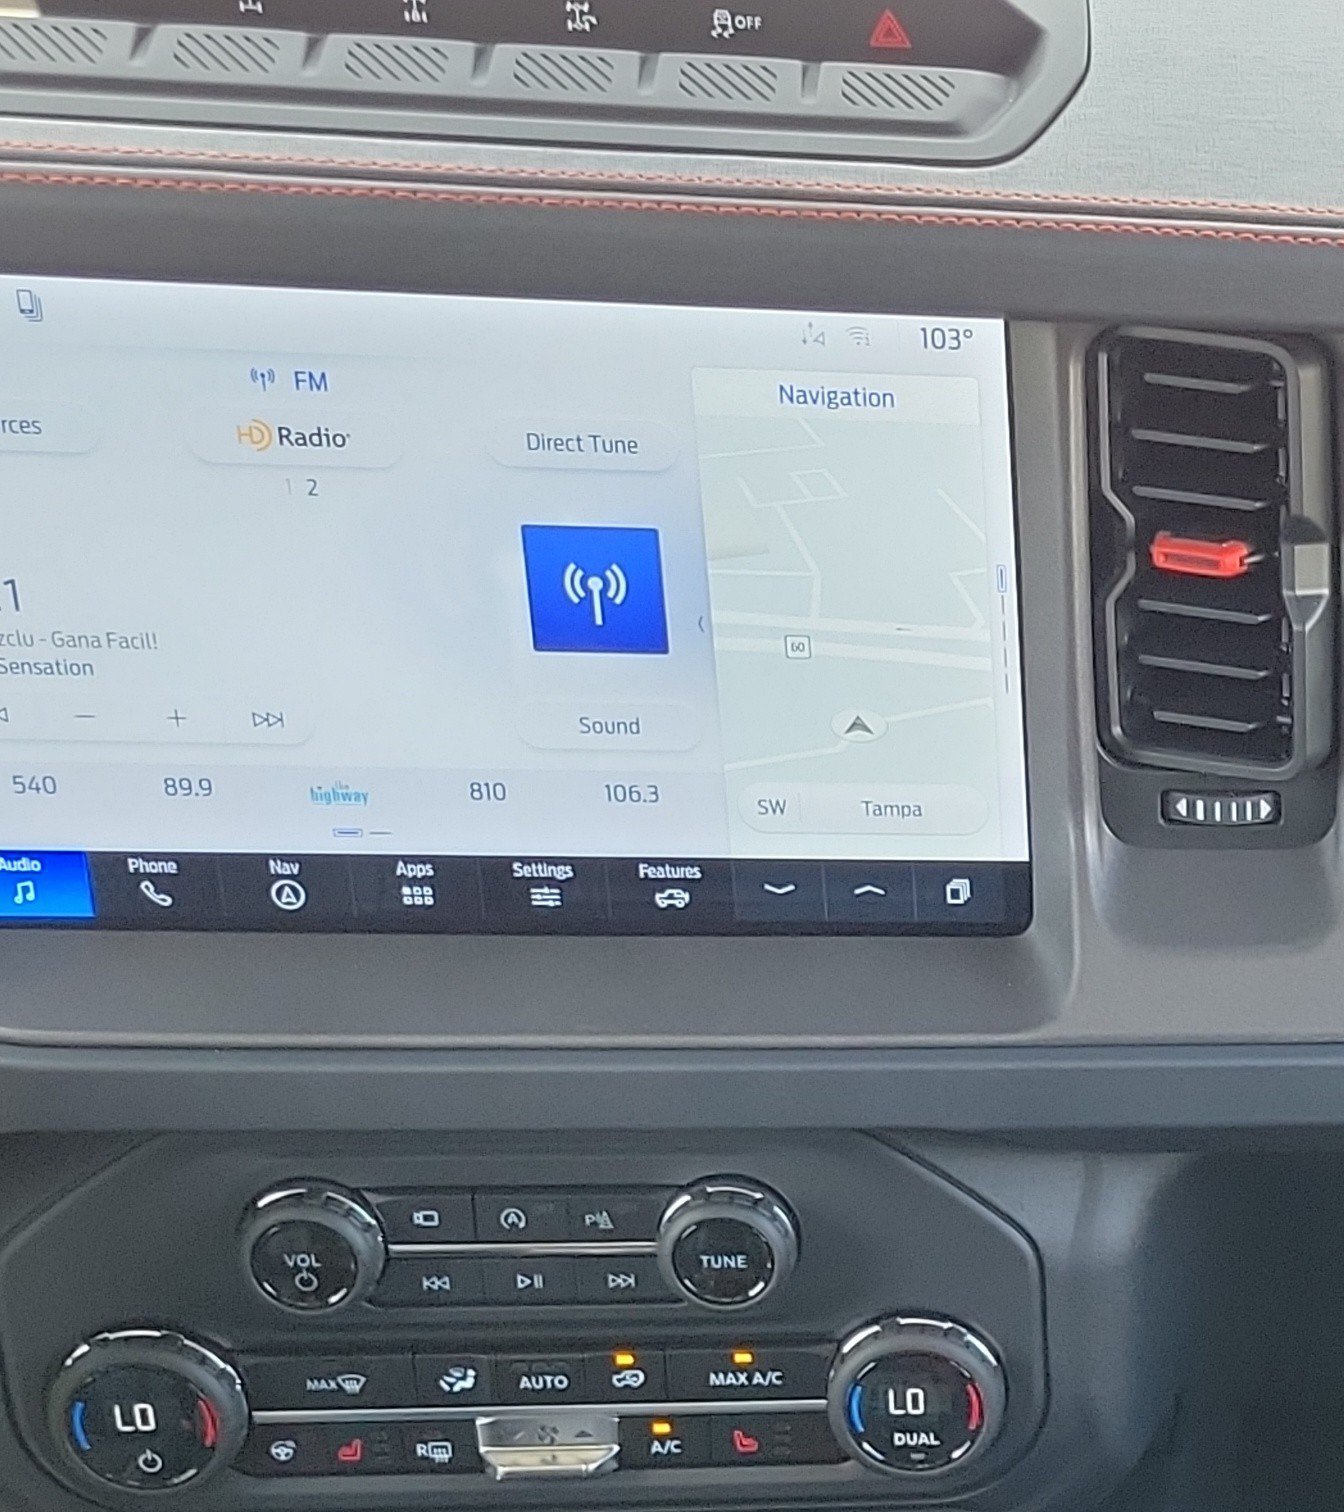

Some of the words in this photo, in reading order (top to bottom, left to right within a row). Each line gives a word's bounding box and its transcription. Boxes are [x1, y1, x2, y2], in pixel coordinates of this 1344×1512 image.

[734, 15, 763, 31] OFF
[919, 326, 974, 351] 103°
[294, 370, 328, 391] FM
[778, 384, 896, 409] Navigation
[277, 426, 346, 448] Radio
[526, 432, 585, 453] Direct
[588, 433, 638, 455] Tune
[306, 478, 319, 497] 2
[51, 630, 102, 649] Gana
[106, 631, 159, 650] Facil!
[0, 657, 94, 677] Sensation
[579, 716, 641, 735] Sound
[12, 775, 57, 795] 540
[163, 777, 213, 797] 89.9
[469, 782, 507, 801] 810
[605, 783, 660, 803] 106.3
[310, 786, 369, 807] highway
[757, 799, 787, 816] SW
[861, 800, 922, 821] Tampa
[0, 856, 42, 872] Audio
[127, 857, 178, 875] Phone
[269, 858, 300, 876] Nav
[395, 860, 434, 879] Apps
[512, 861, 574, 881] Settings
[638, 863, 702, 880] Features
[285, 1254, 322, 1269] VOL
[700, 1255, 748, 1270] TUNE
[306, 1378, 338, 1391] MAX
[519, 1375, 570, 1391] AUTO
[709, 1372, 749, 1386] MAX
[752, 1370, 783, 1386] A/C
[887, 1388, 925, 1415] LO
[114, 1403, 157, 1432] LO
[651, 1440, 682, 1454] A/C
[893, 1432, 941, 1446] DUAL
